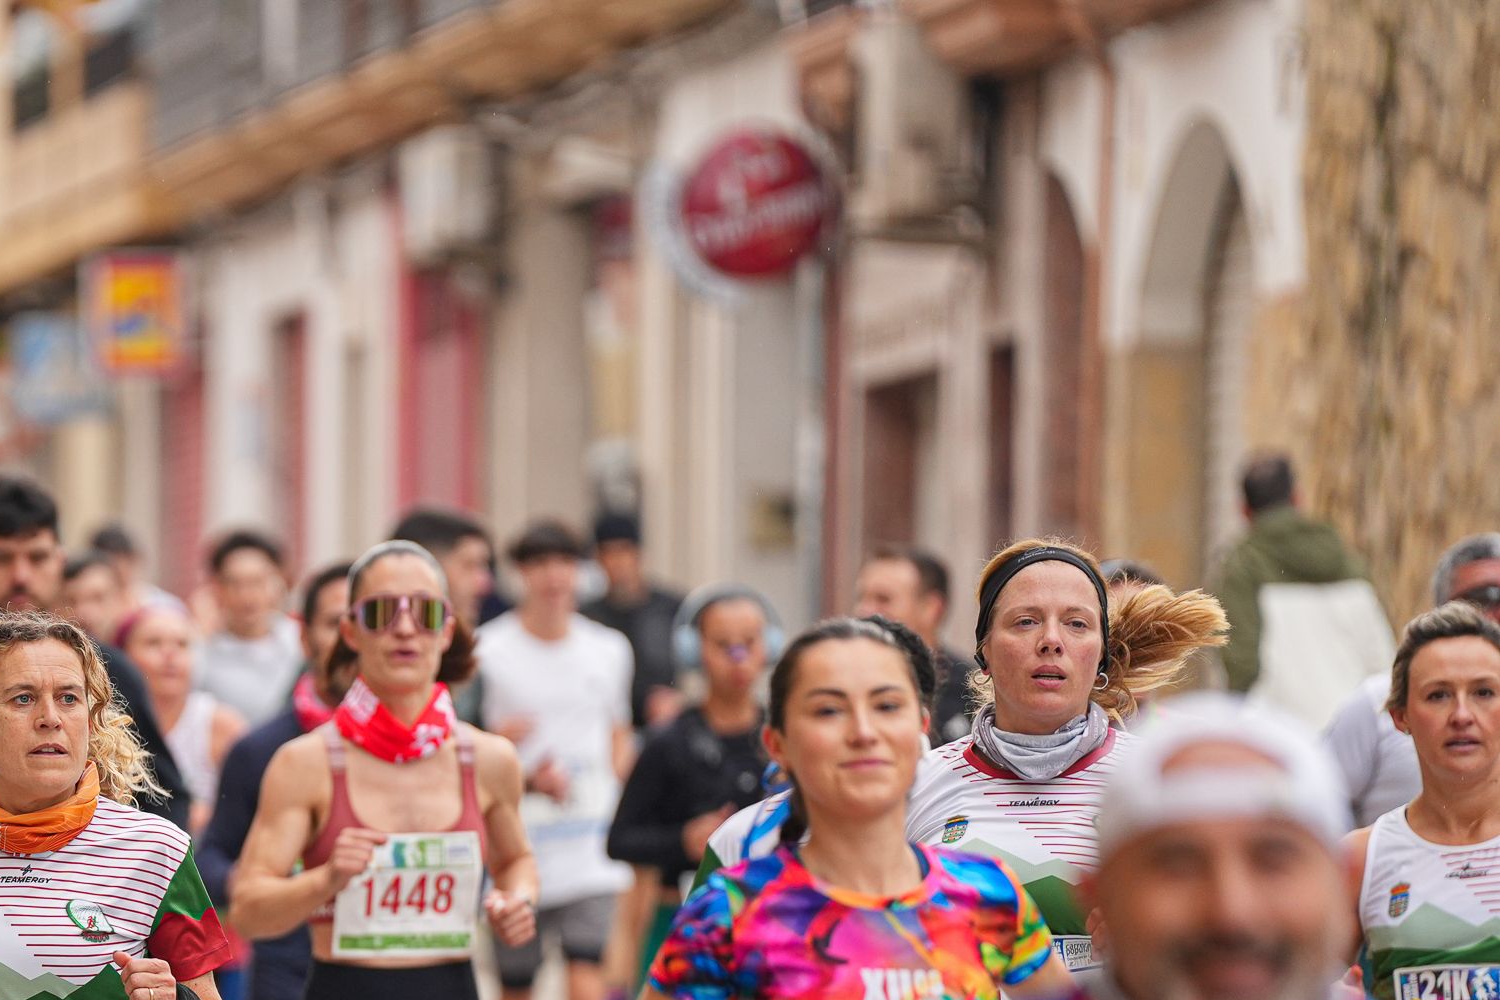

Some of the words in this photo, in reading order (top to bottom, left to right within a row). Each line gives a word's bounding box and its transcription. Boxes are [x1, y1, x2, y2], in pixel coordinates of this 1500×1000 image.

[1009, 799, 1060, 807] TEAMERGY
[361, 872, 456, 917] 1448
[1420, 970, 1471, 1000] 21K
